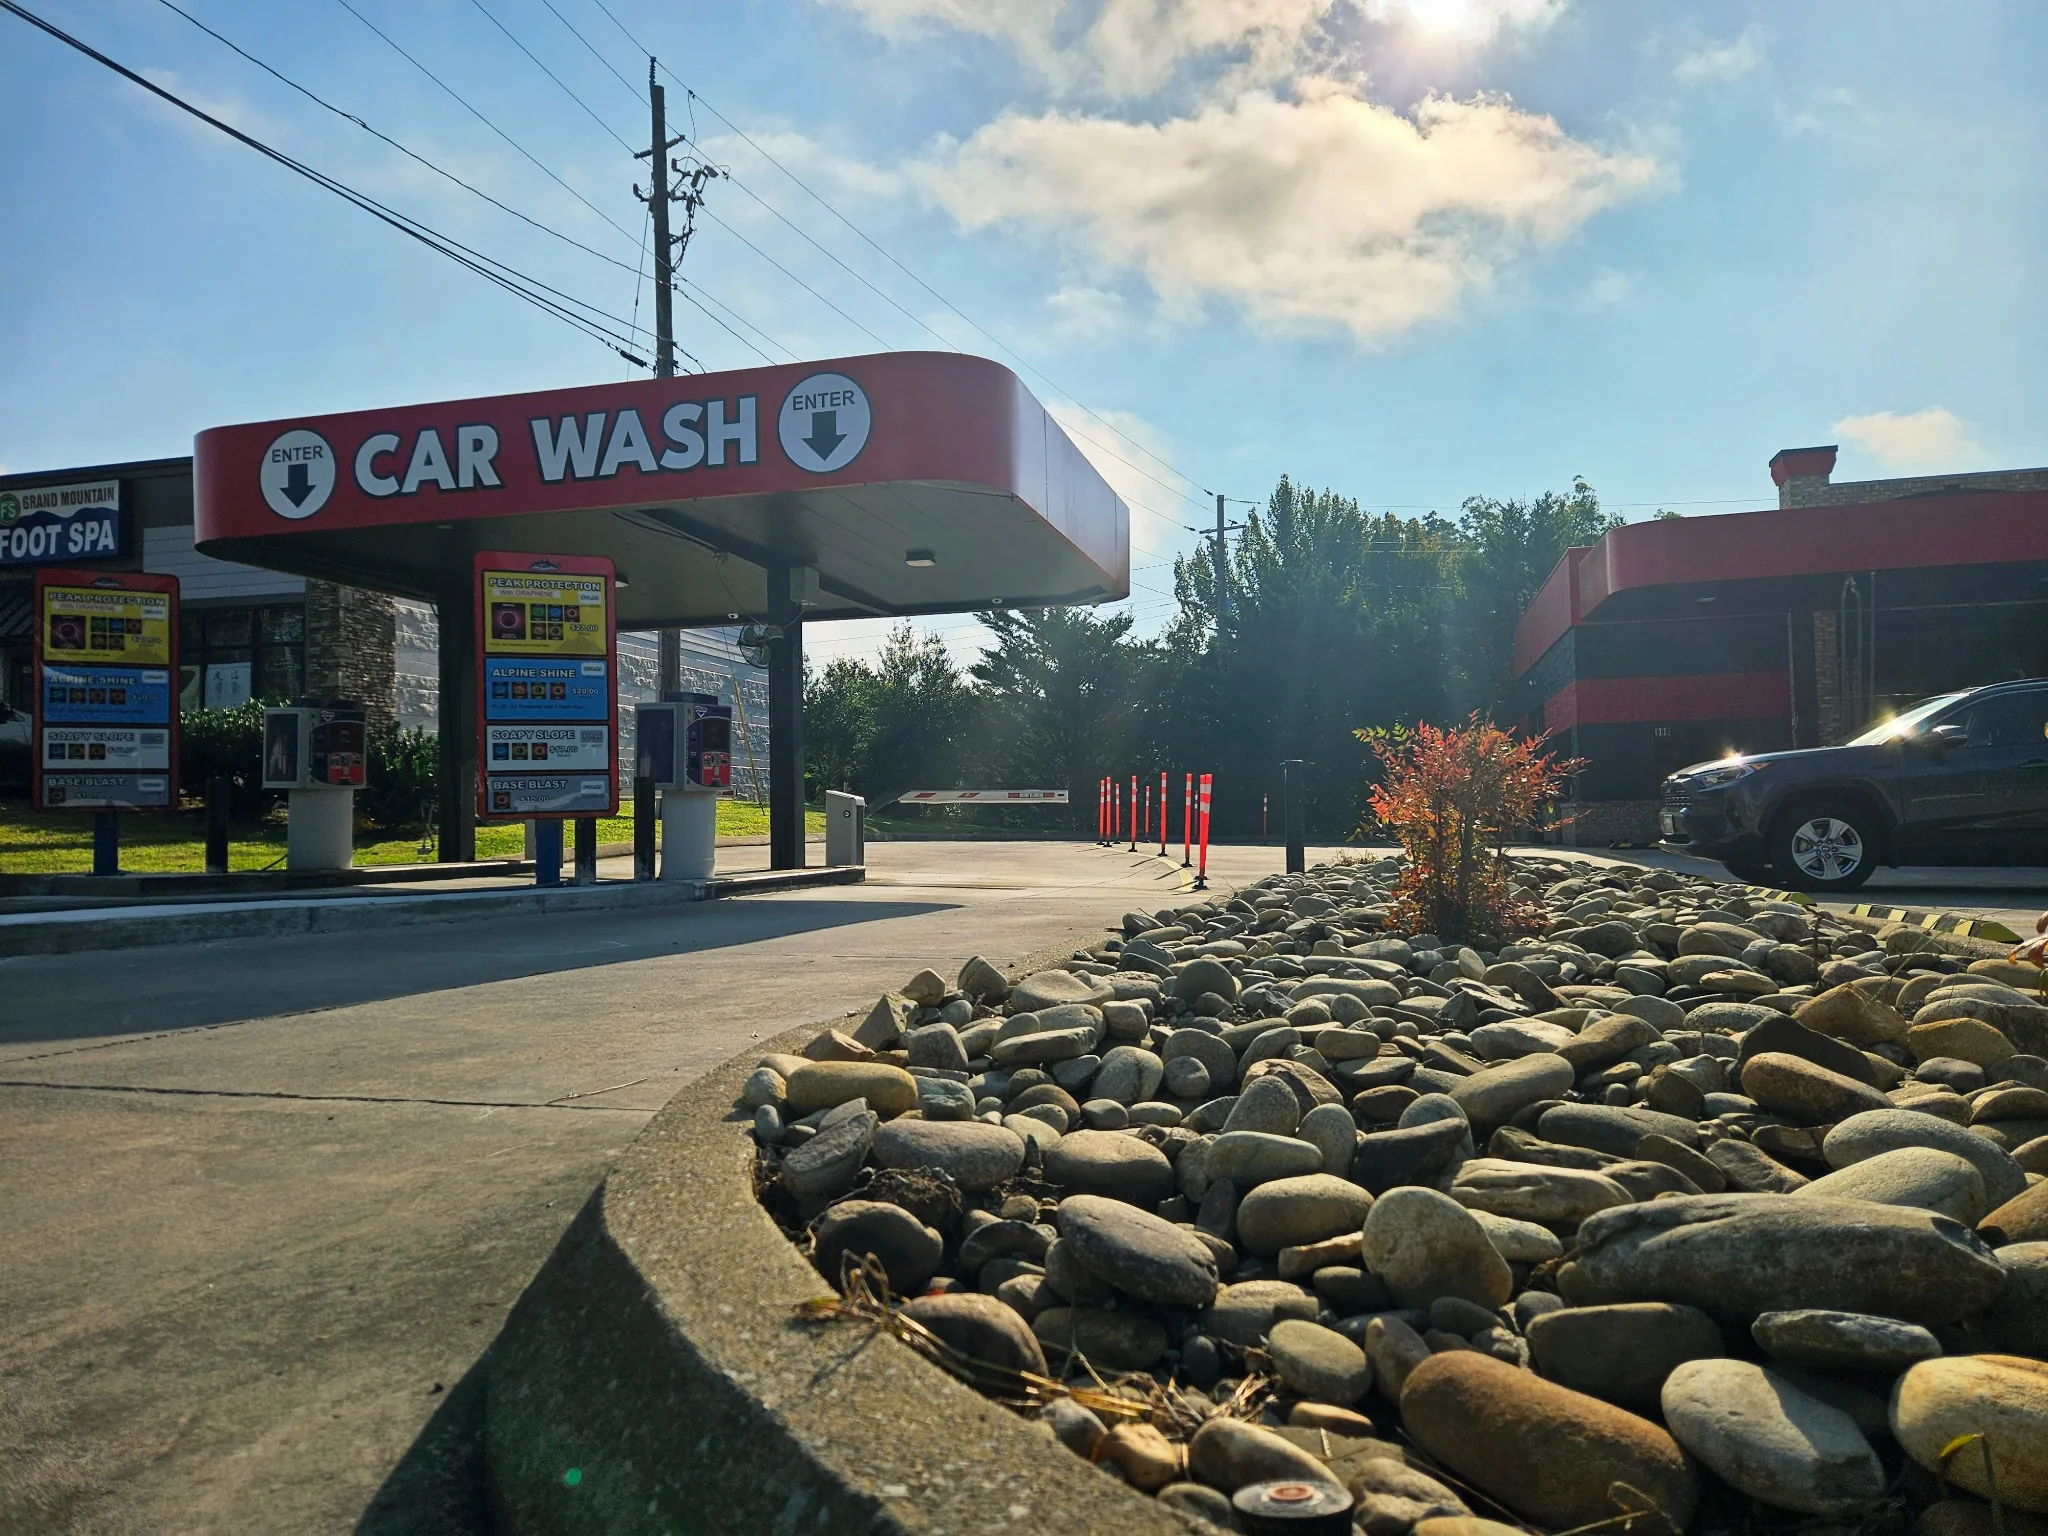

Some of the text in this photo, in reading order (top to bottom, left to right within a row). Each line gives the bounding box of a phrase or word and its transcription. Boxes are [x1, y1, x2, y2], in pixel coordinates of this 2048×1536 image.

[792, 389, 855, 411] ENTER
[271, 443, 324, 463] ENTER
[354, 395, 759, 497] CAR WASH
[22, 486, 115, 509] GRAND MOUNTAIN
[0, 519, 115, 559] FOOT SPA
[489, 577, 601, 591] PEAK PROTECTION
[49, 592, 83, 601] PEAK
[85, 594, 165, 606] PROTECTION
[49, 675, 96, 684] ALPINE
[99, 676, 137, 685] SHINE
[492, 668, 536, 678] ALPINE
[539, 668, 576, 678] SHINE
[48, 731, 92, 741] SOAPY
[93, 732, 135, 742] SLOPE
[492, 729, 534, 740] SOAPY
[535, 729, 576, 740] SLOPE
[48, 777, 126, 786] BASE BLAST
[493, 779, 568, 790] BASE BLAST
